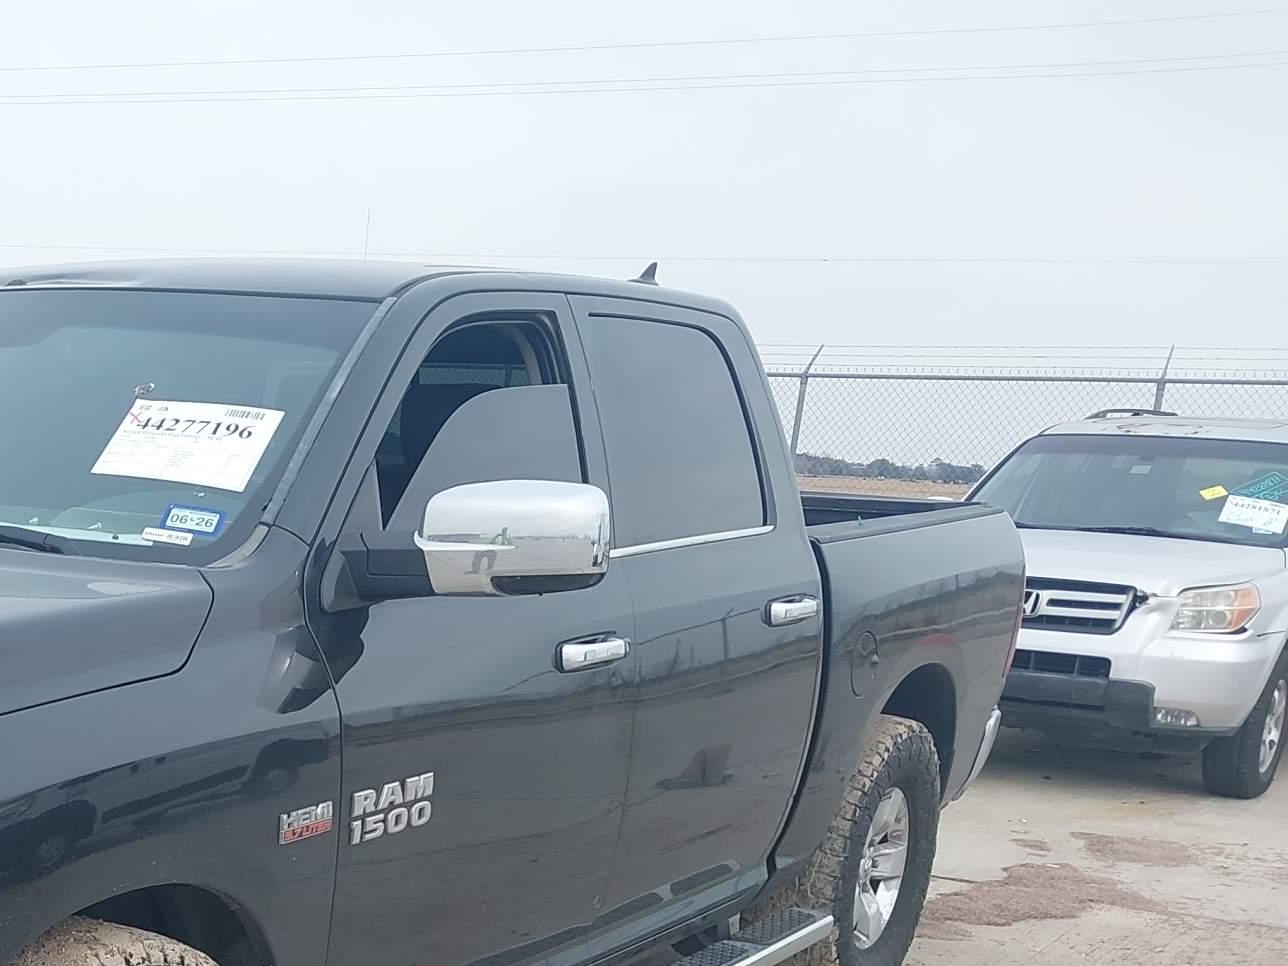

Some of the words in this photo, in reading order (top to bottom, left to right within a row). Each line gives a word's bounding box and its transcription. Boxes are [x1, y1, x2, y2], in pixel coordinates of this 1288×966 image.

[137, 417, 255, 440] 44277196
[352, 772, 434, 818] RAM
[280, 801, 332, 830] HEMI
[350, 801, 432, 845] 1500
